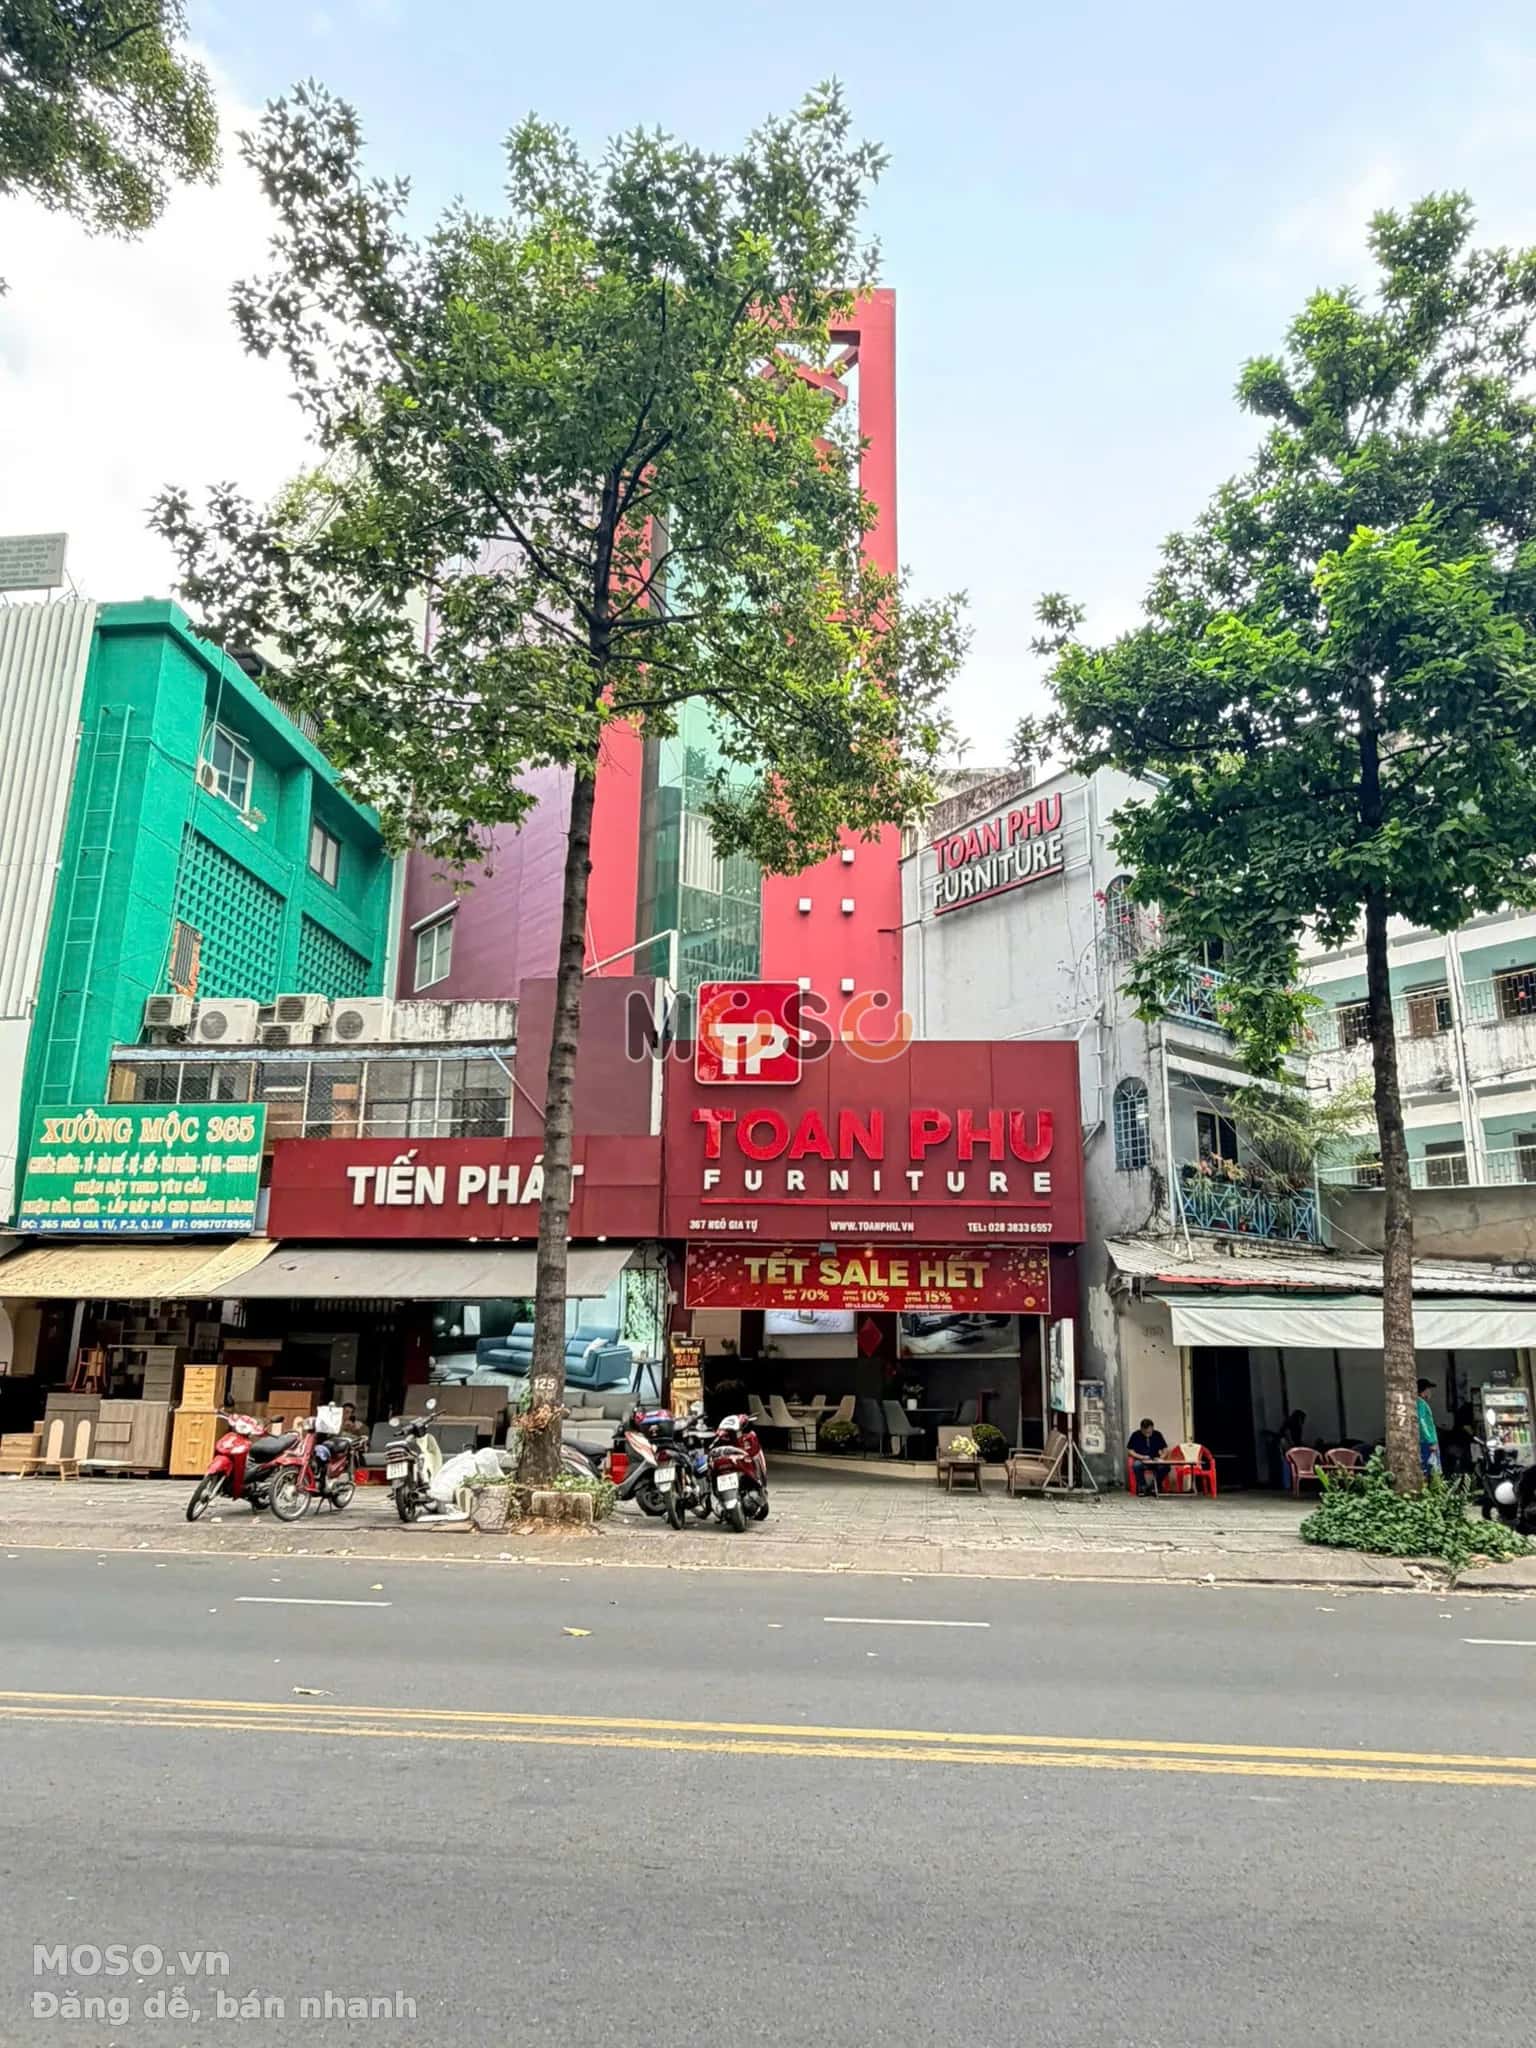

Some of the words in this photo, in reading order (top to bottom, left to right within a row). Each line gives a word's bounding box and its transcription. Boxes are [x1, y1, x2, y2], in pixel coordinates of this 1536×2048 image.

[932, 819, 1001, 873] TOAN
[1007, 792, 1062, 846] PHU
[933, 834, 1063, 908] FURNITURE
[40, 1108, 133, 1143] XƯỞNG
[139, 1110, 199, 1149] MỘC
[206, 1115, 255, 1143] 365
[691, 1108, 885, 1161] TOAN
[909, 1109, 1054, 1162] PHU
[347, 1149, 446, 1206] TIẾN
[703, 1169, 1052, 1193] FURNITURE
[83, 1219, 99, 1229] GIA
[728, 1220, 744, 1229] GIA
[830, 1221, 915, 1232] WWW.TOANPHU.VN
[967, 1222, 987, 1232] TEL:
[744, 1248, 809, 1284] TẾT
[818, 1258, 909, 1287] SALE
[920, 1250, 990, 1289] HẾT
[800, 1289, 829, 1302] 70%
[861, 1290, 889, 1303] 10%
[924, 1290, 951, 1303] 15%
[534, 1378, 556, 1390] 125
